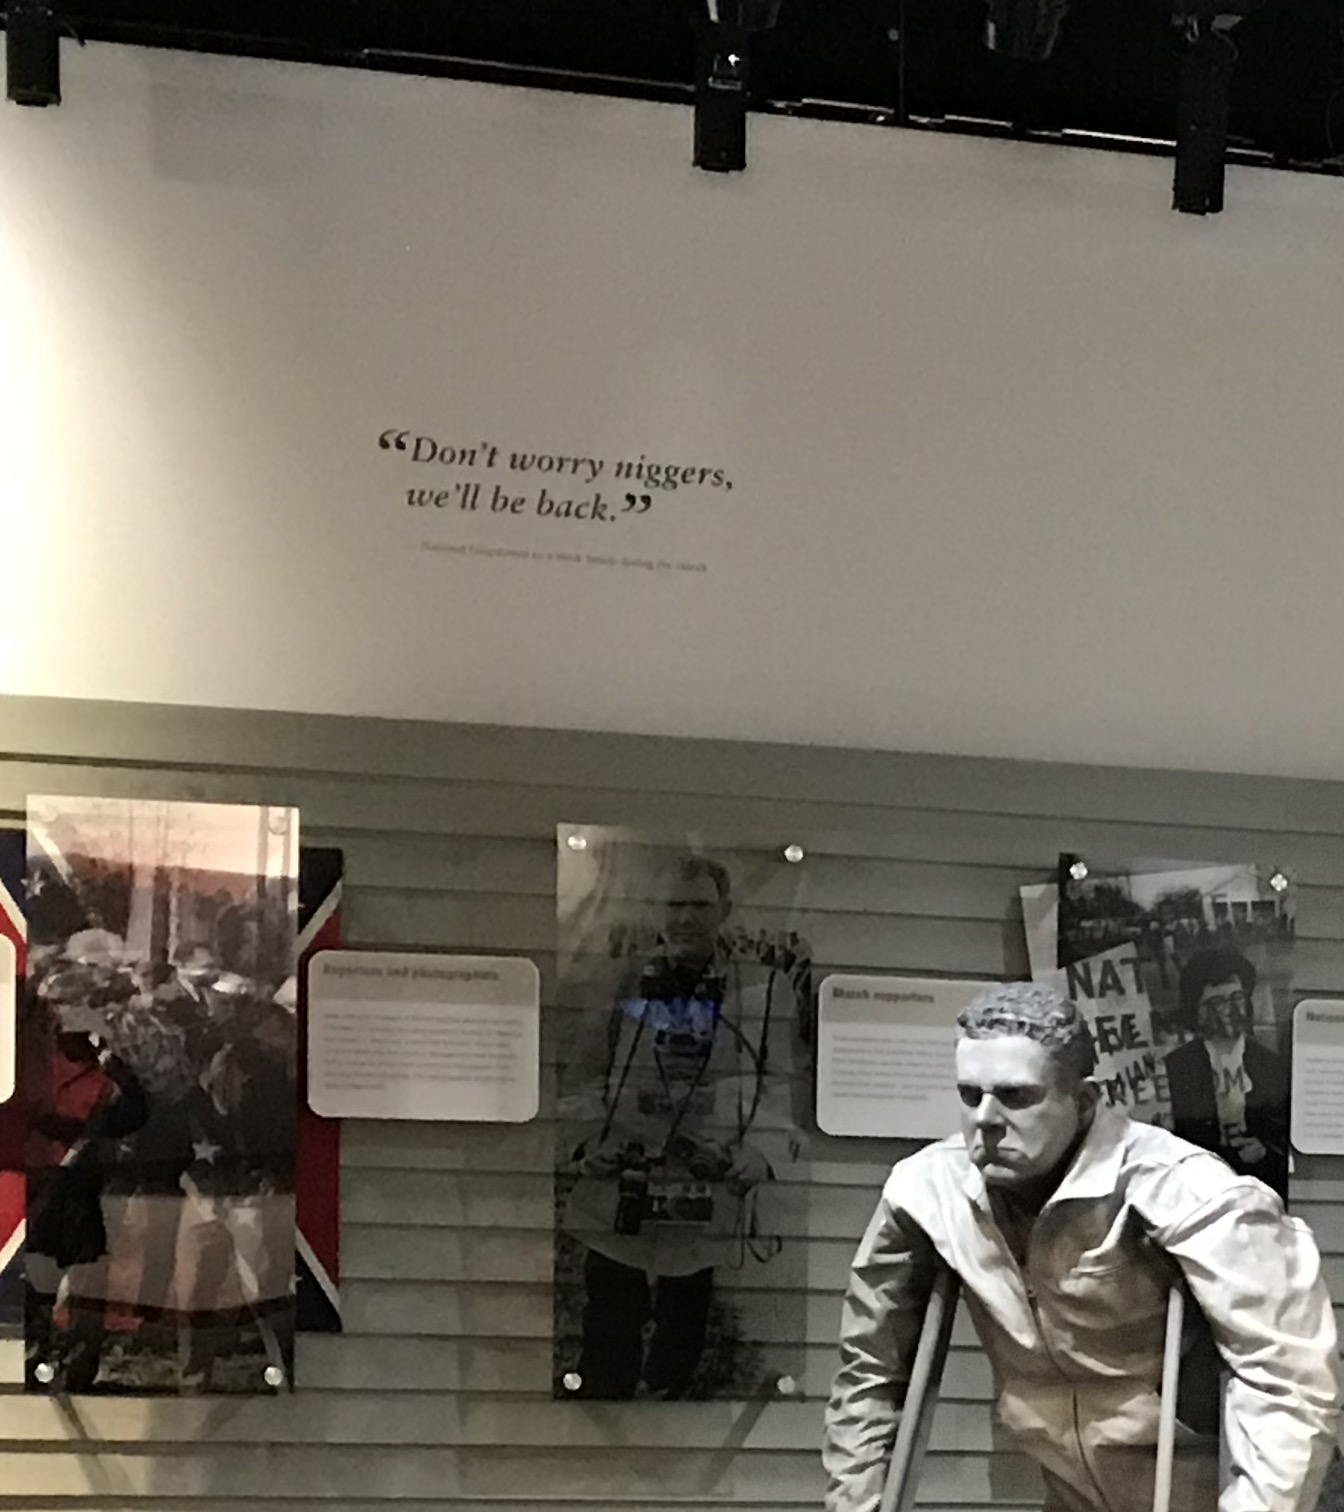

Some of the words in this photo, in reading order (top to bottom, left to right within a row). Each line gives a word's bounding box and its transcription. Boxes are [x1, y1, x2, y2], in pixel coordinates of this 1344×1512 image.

[508, 450, 604, 482] worry
[614, 454, 735, 491] niggers,
[490, 485, 527, 515] be
